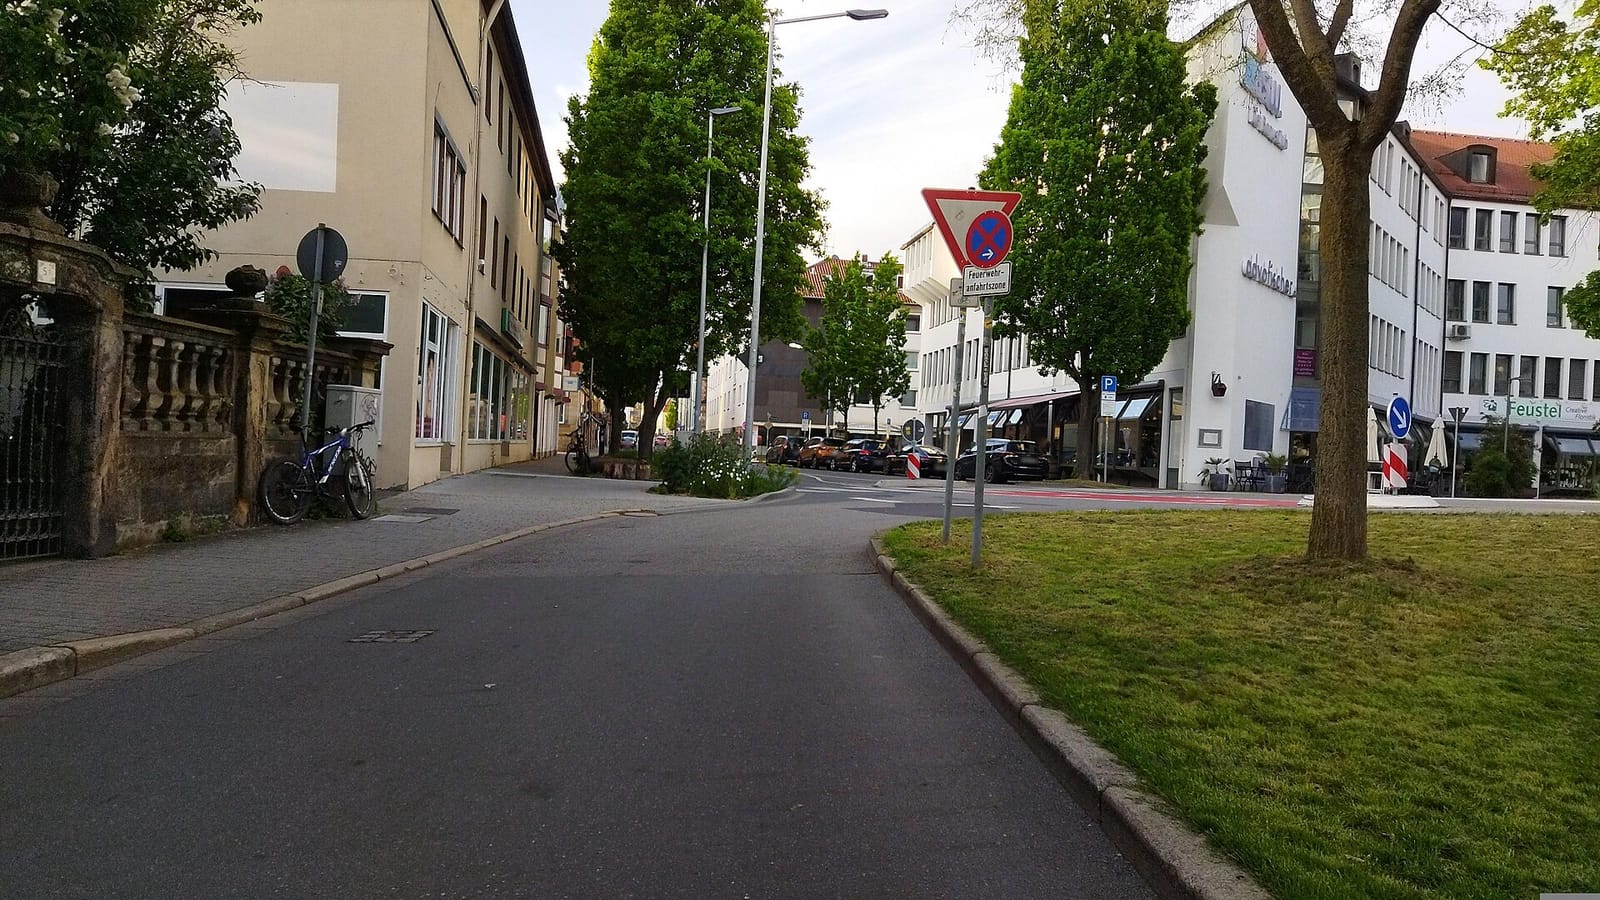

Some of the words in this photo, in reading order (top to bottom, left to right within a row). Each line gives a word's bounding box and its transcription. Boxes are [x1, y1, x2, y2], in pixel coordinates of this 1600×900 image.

[968, 269, 1005, 280] Feuerwehr-
[966, 281, 1006, 292] anfahrtszone
[1104, 378, 1114, 390] P
[1508, 401, 1562, 418] Feustel
